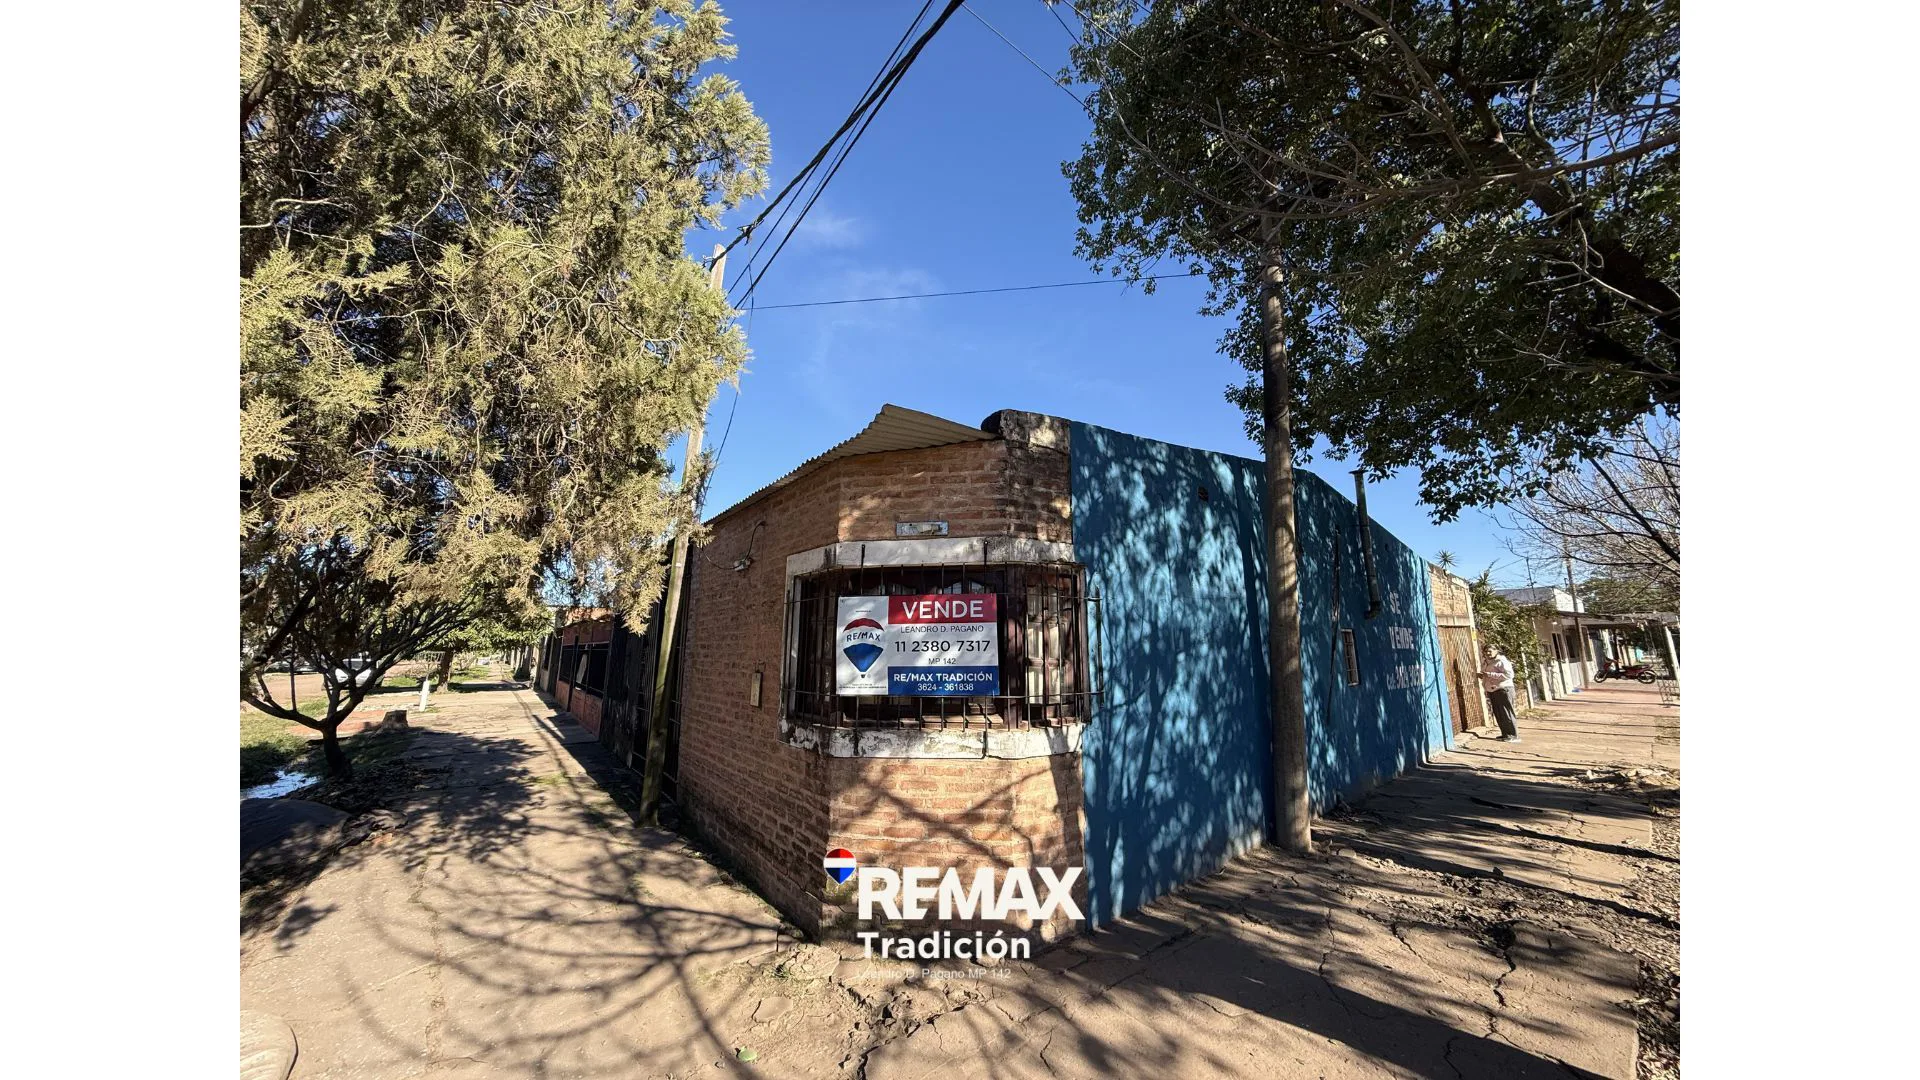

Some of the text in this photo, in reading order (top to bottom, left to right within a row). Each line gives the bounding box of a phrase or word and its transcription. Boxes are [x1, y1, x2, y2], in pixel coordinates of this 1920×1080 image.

[1389, 592, 1401, 614] SE
[902, 600, 984, 619] VENDE
[900, 625, 984, 634] LEANDRO D. PAGANO
[846, 631, 881, 642] RE/MAX
[1389, 626, 1414, 649] VENDE
[895, 640, 991, 653] 11 2380 7317
[893, 671, 993, 682] RE/MAX TRADICIÓN
[917, 683, 937, 691] 3624
[944, 683, 974, 691] 361838
